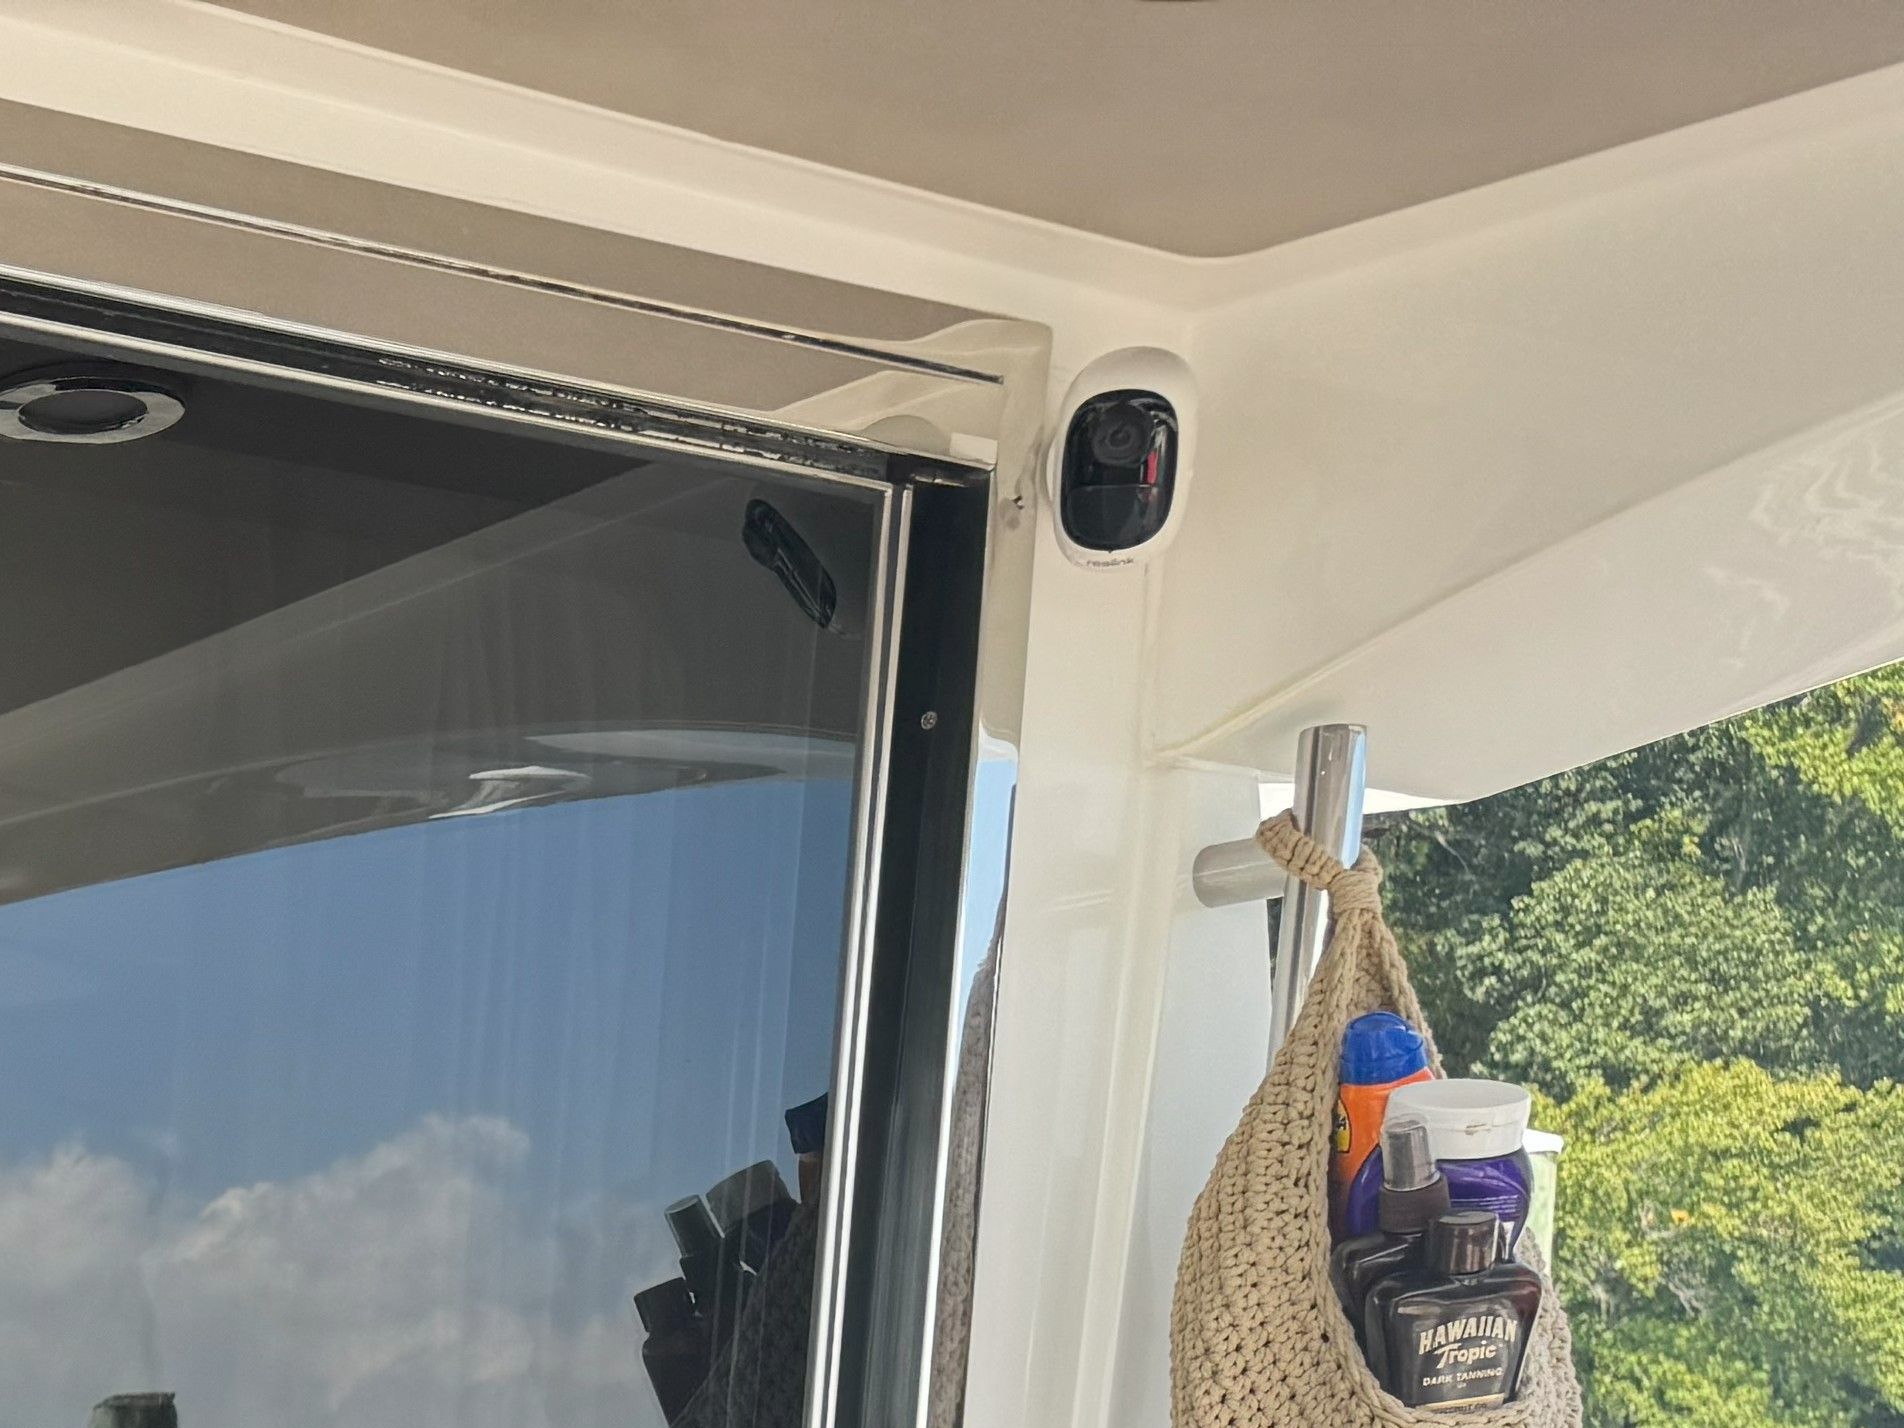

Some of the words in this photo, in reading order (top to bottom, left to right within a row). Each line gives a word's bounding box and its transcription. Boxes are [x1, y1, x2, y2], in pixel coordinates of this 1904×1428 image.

[1418, 1315, 1518, 1355] HAWAIIAN
[1433, 1340, 1498, 1369] Tropic
[1423, 1375, 1453, 1387] DARK
[1456, 1367, 1503, 1382] TANNING
